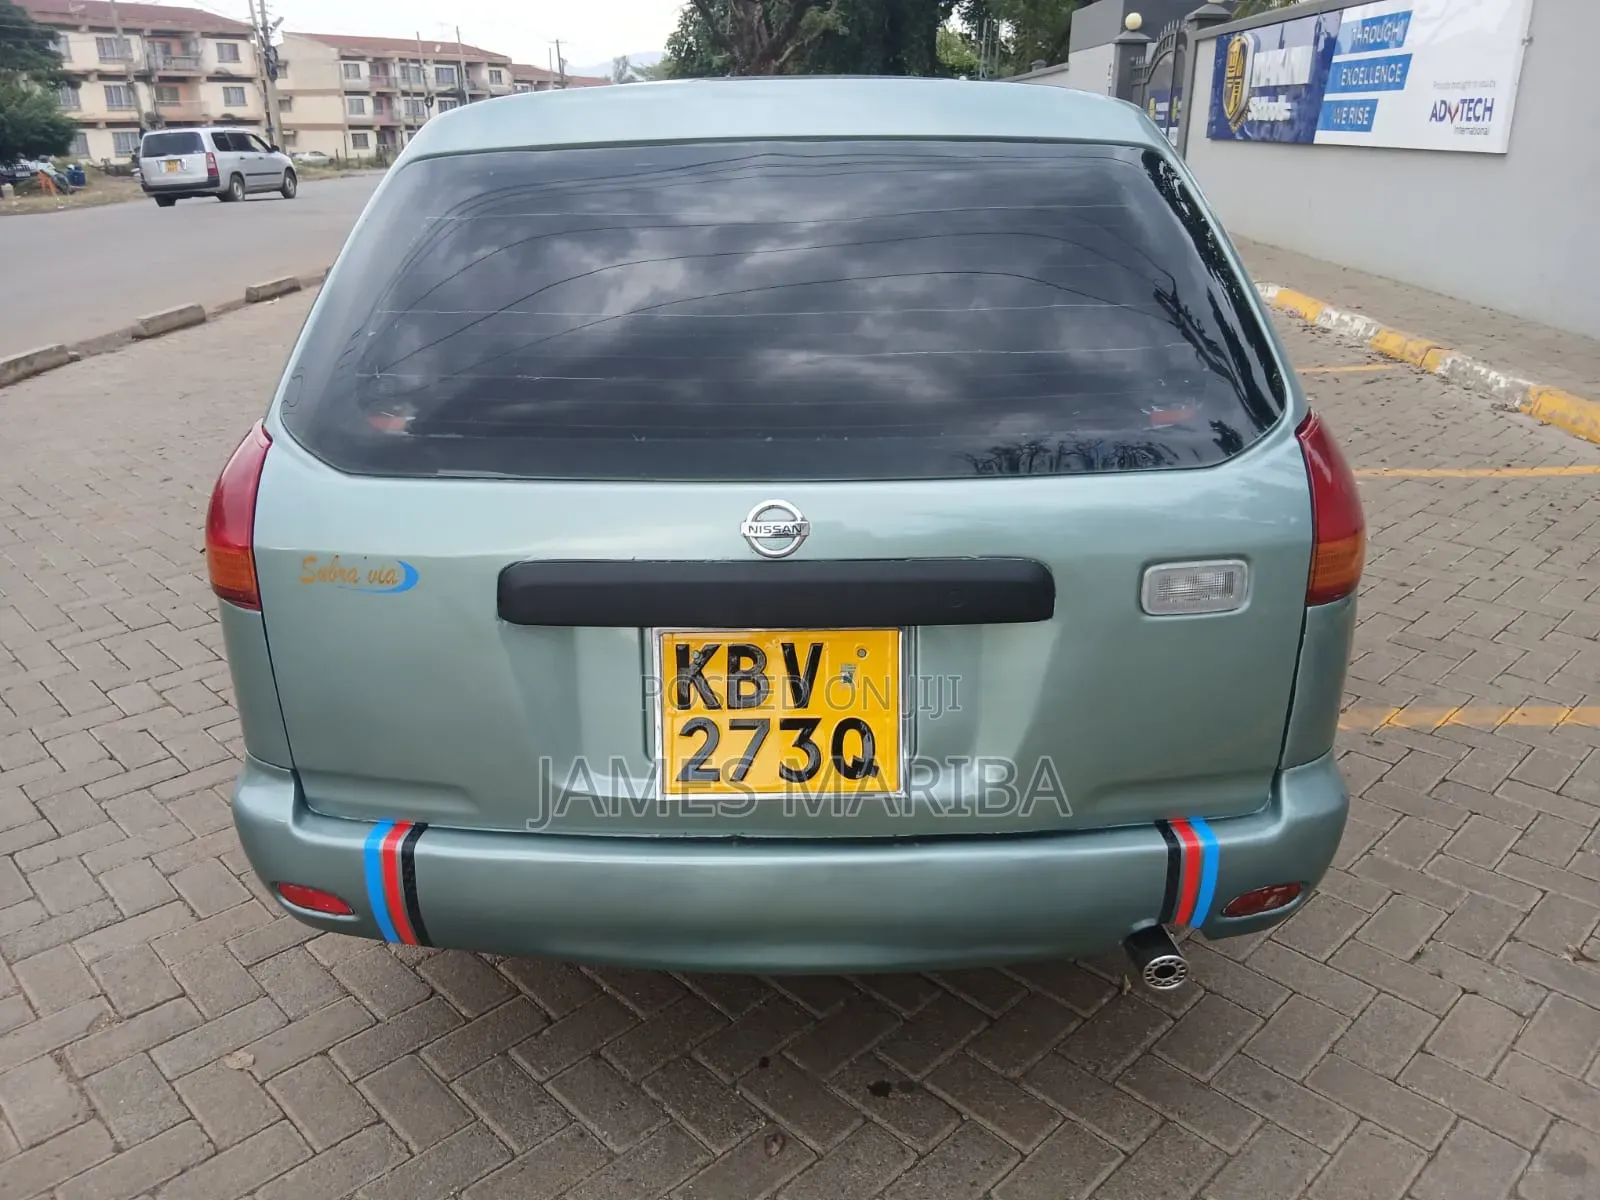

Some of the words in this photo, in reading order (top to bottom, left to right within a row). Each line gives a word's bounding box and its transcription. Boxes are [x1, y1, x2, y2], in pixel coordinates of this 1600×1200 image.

[1352, 21, 1402, 45] THROUGH
[1341, 64, 1403, 86] EXCELLENCE
[1333, 107, 1348, 125] WE
[1349, 107, 1371, 125] RISE
[748, 525, 802, 534] NISSAN
[675, 641, 824, 710] KBV
[676, 717, 880, 784] 273Q
